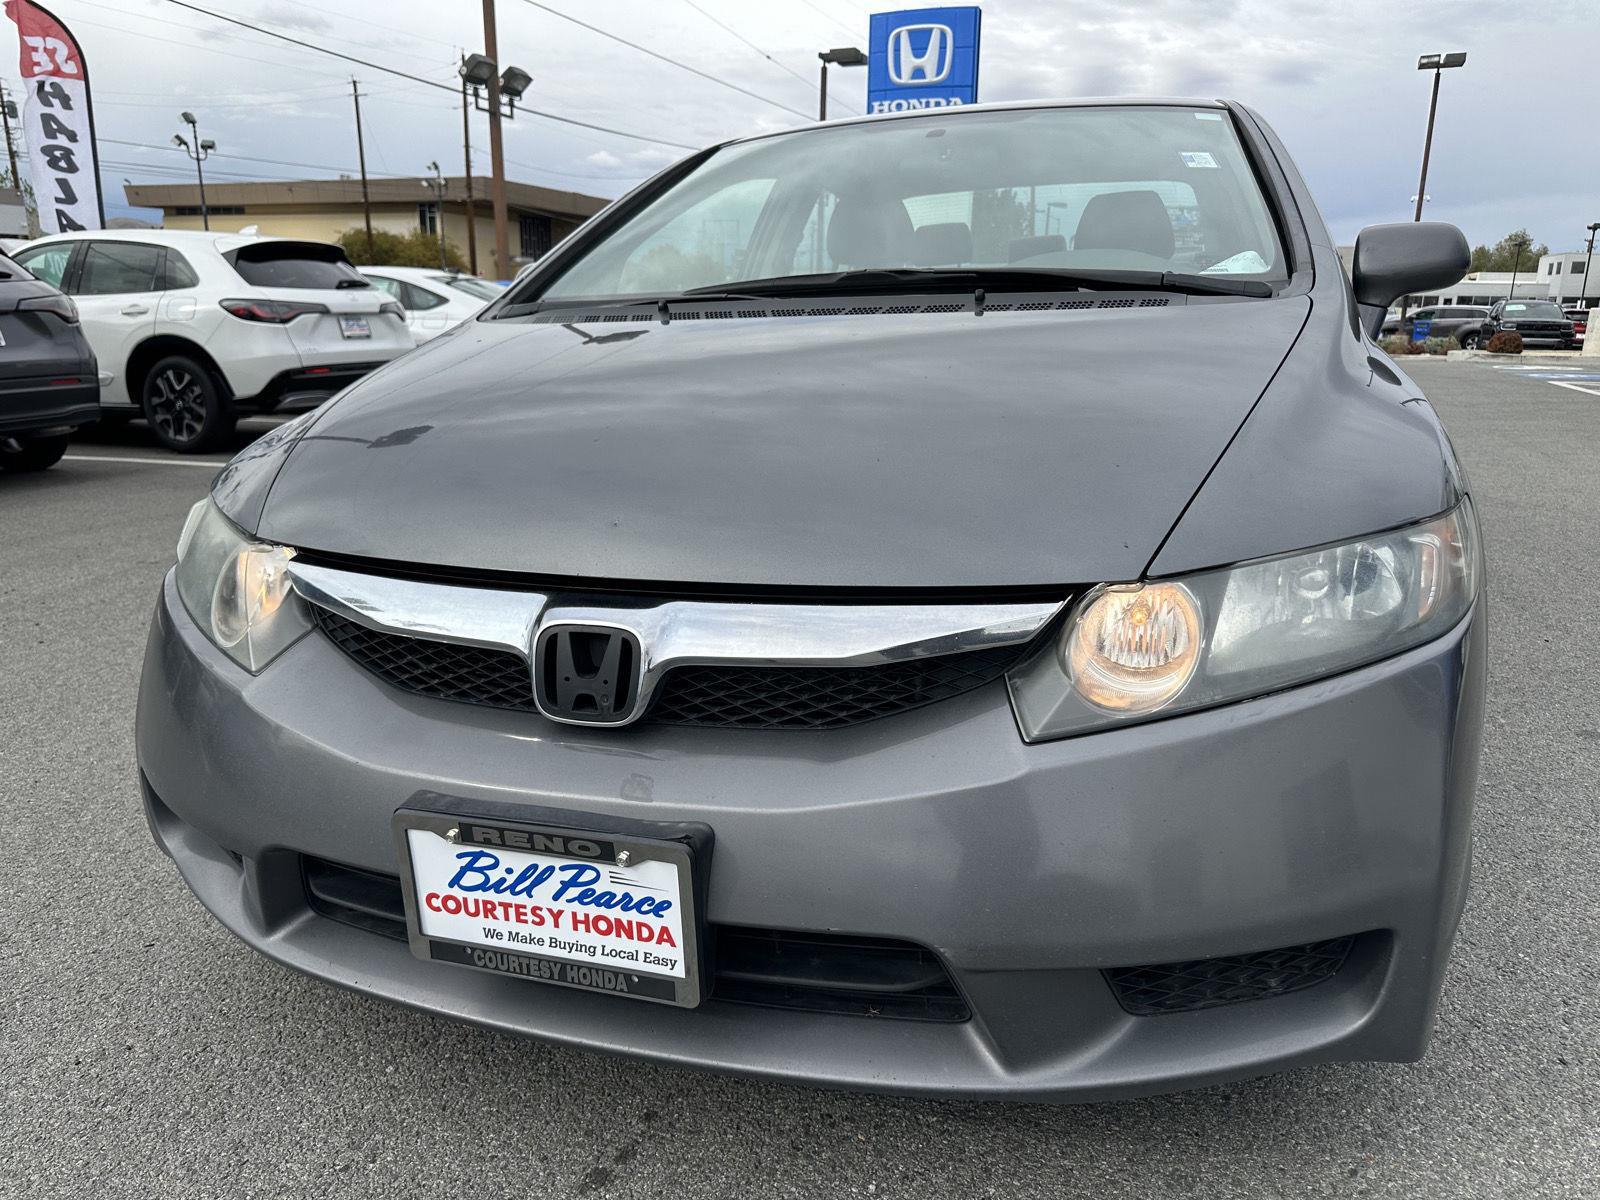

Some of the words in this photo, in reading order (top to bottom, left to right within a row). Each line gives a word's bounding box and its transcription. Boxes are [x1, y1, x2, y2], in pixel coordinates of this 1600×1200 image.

[471, 826, 602, 857] RENO
[448, 850, 556, 898] Bill
[552, 863, 672, 918] Pearce
[425, 892, 565, 929] COURTESY
[571, 911, 677, 948] HONDA
[473, 950, 563, 981] COURTESY
[566, 965, 629, 992] HONDA
[482, 927, 504, 941] We
[507, 930, 545, 947] Make
[548, 936, 597, 957] Buying
[601, 944, 639, 962] Local
[643, 952, 678, 971] Easy
